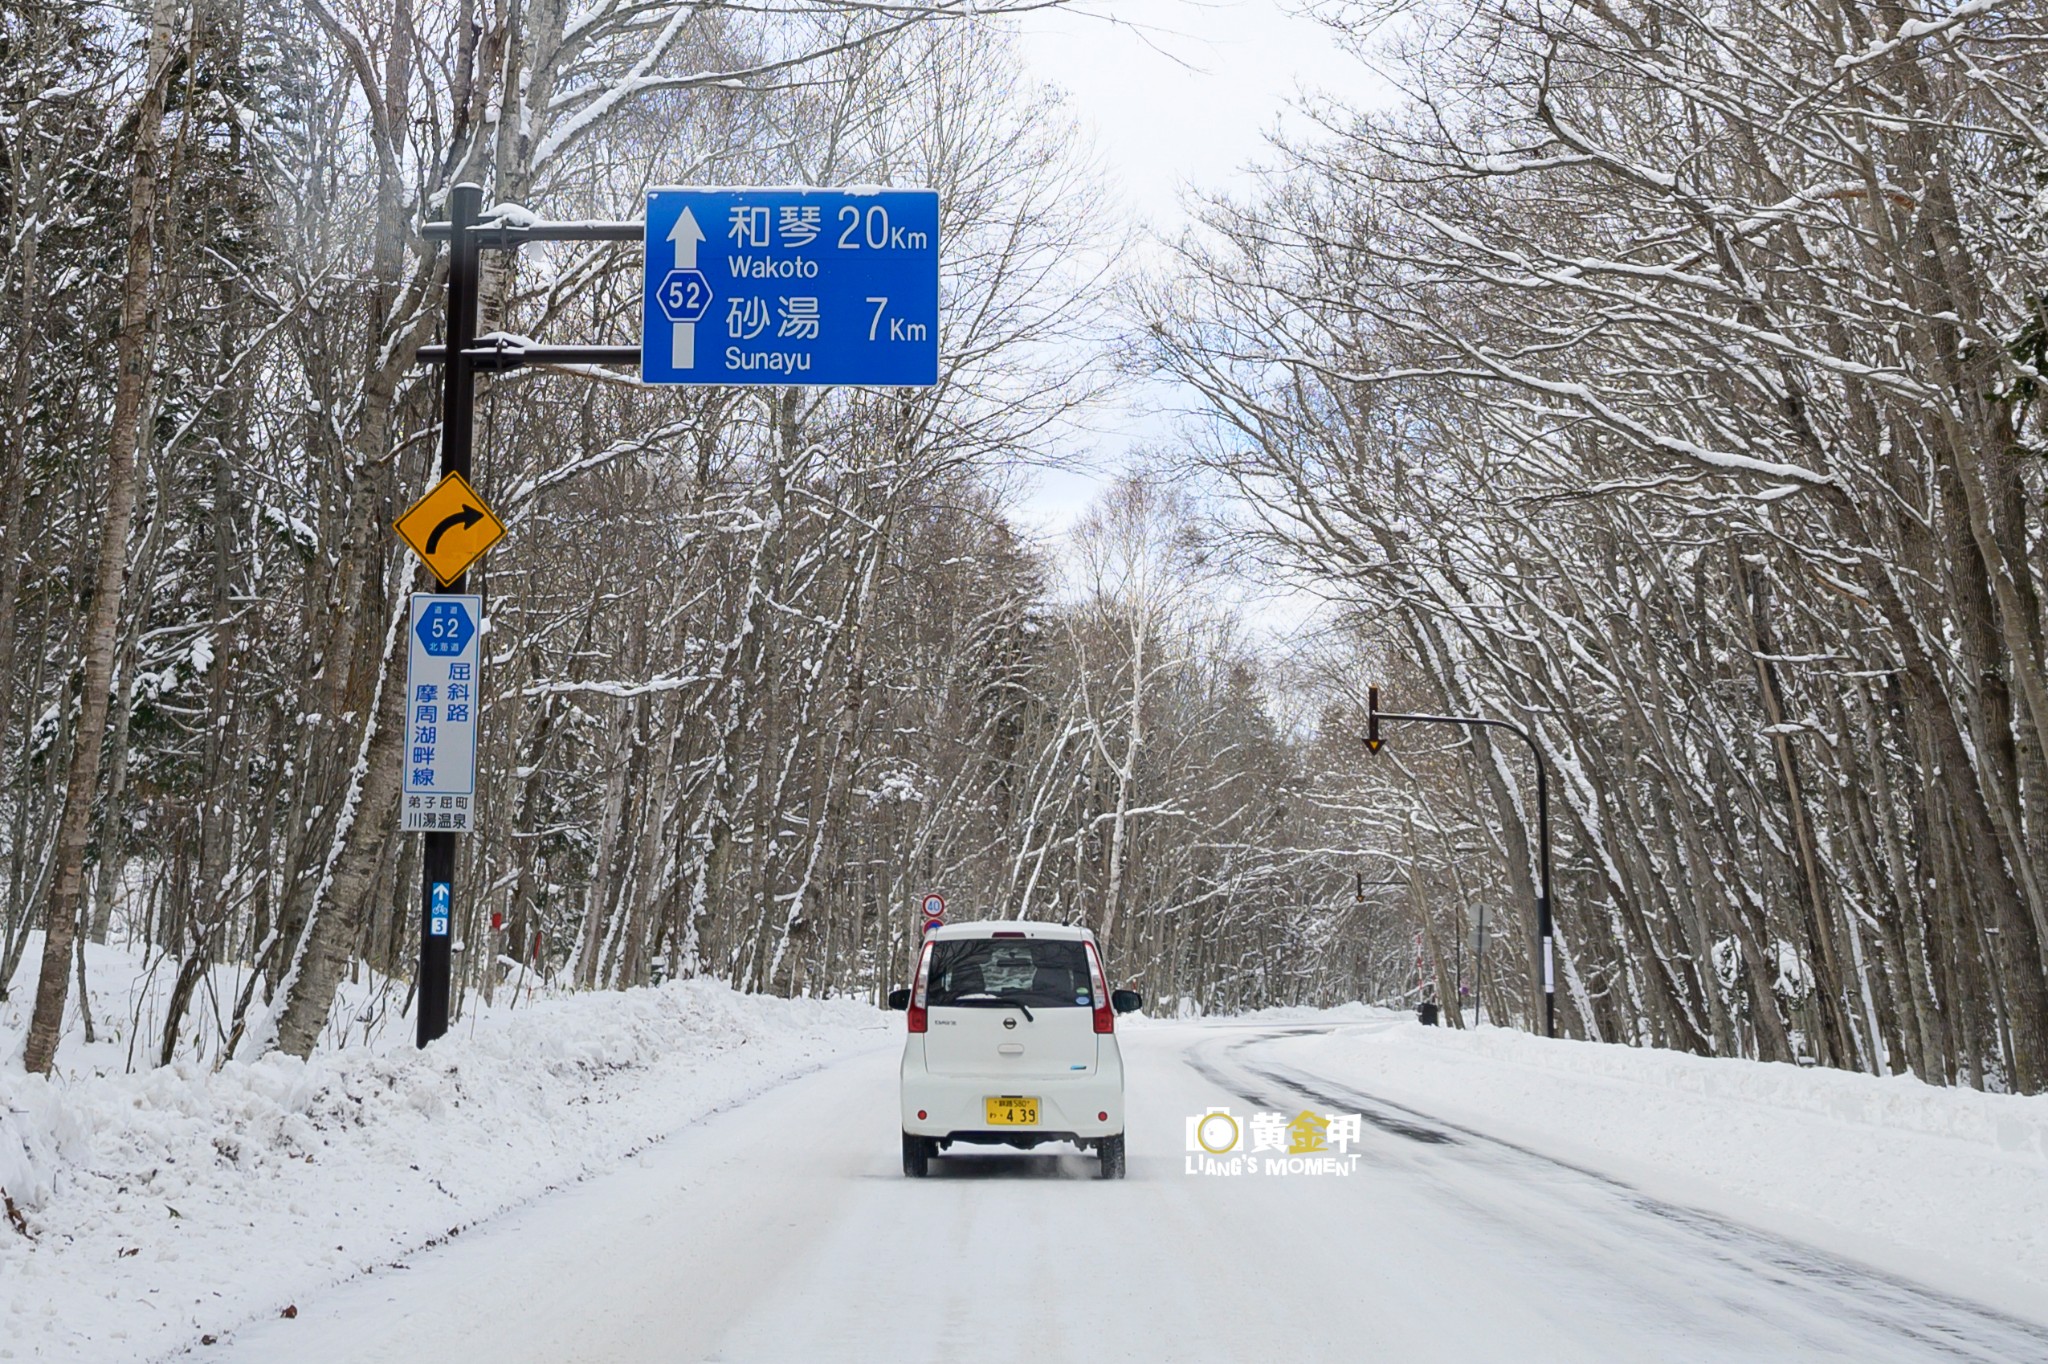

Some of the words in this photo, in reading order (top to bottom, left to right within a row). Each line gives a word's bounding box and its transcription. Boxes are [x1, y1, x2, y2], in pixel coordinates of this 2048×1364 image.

[727, 205, 821, 248] 和琴
[728, 255, 819, 279] Wakoto
[668, 281, 701, 309] 52
[725, 296, 821, 340] 砂湯
[725, 346, 811, 375] Sunayu
[432, 617, 459, 638] 52
[446, 662, 471, 723] 屈斜路
[412, 684, 438, 787] 摩周湖畔線
[408, 795, 469, 810] 弟子屈町
[408, 812, 467, 829] 川湯温泉
[927, 900, 940, 911] 40
[435, 919, 444, 933] 3
